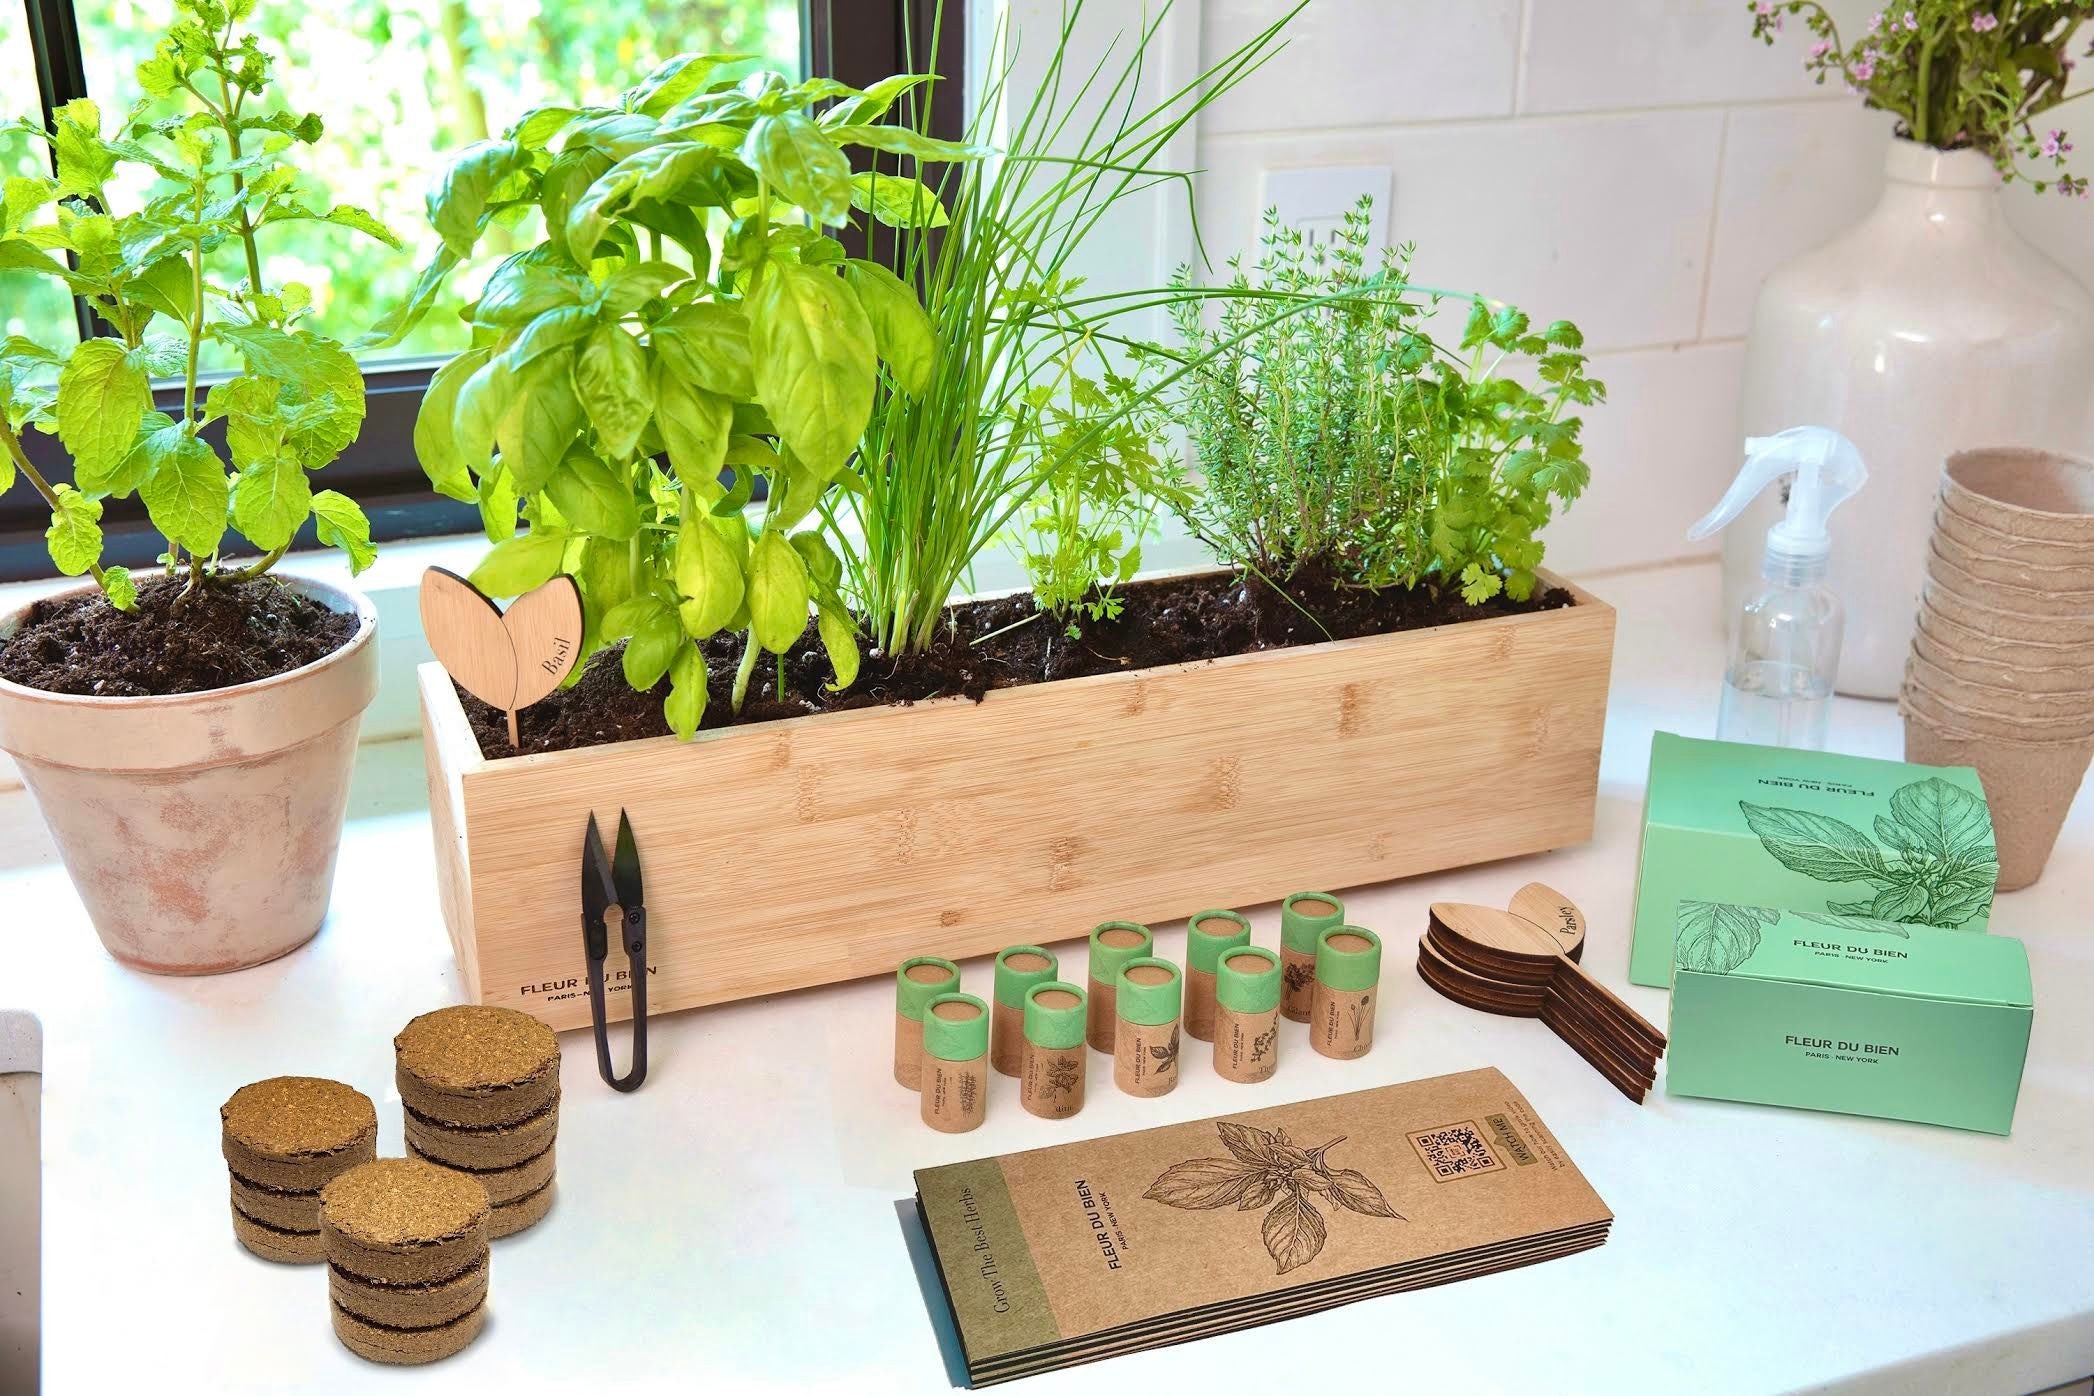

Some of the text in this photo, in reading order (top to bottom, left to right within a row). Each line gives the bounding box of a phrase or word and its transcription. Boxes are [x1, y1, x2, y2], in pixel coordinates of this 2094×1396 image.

[541, 637, 570, 675] Basil
[1758, 779, 1875, 797] FLEUR DU BIEN
[1559, 906, 1577, 935] Parsley
[1793, 939, 1908, 959] FLEUR DU BIEN
[520, 978, 578, 995] FLEUR
[1785, 1035, 1899, 1056] FLEUR DU BIEN
[1805, 1051, 1830, 1060] PARIS
[1502, 1131, 1529, 1161] WATCH
[1099, 1191, 1111, 1211] YORK
[1074, 1179, 1122, 1270] FLEUR DU BIEN
[1106, 1212, 1119, 1227] NEW
[959, 1187, 1011, 1313] Grow The Best Herbs
[1115, 1230, 1129, 1250] PARIS
